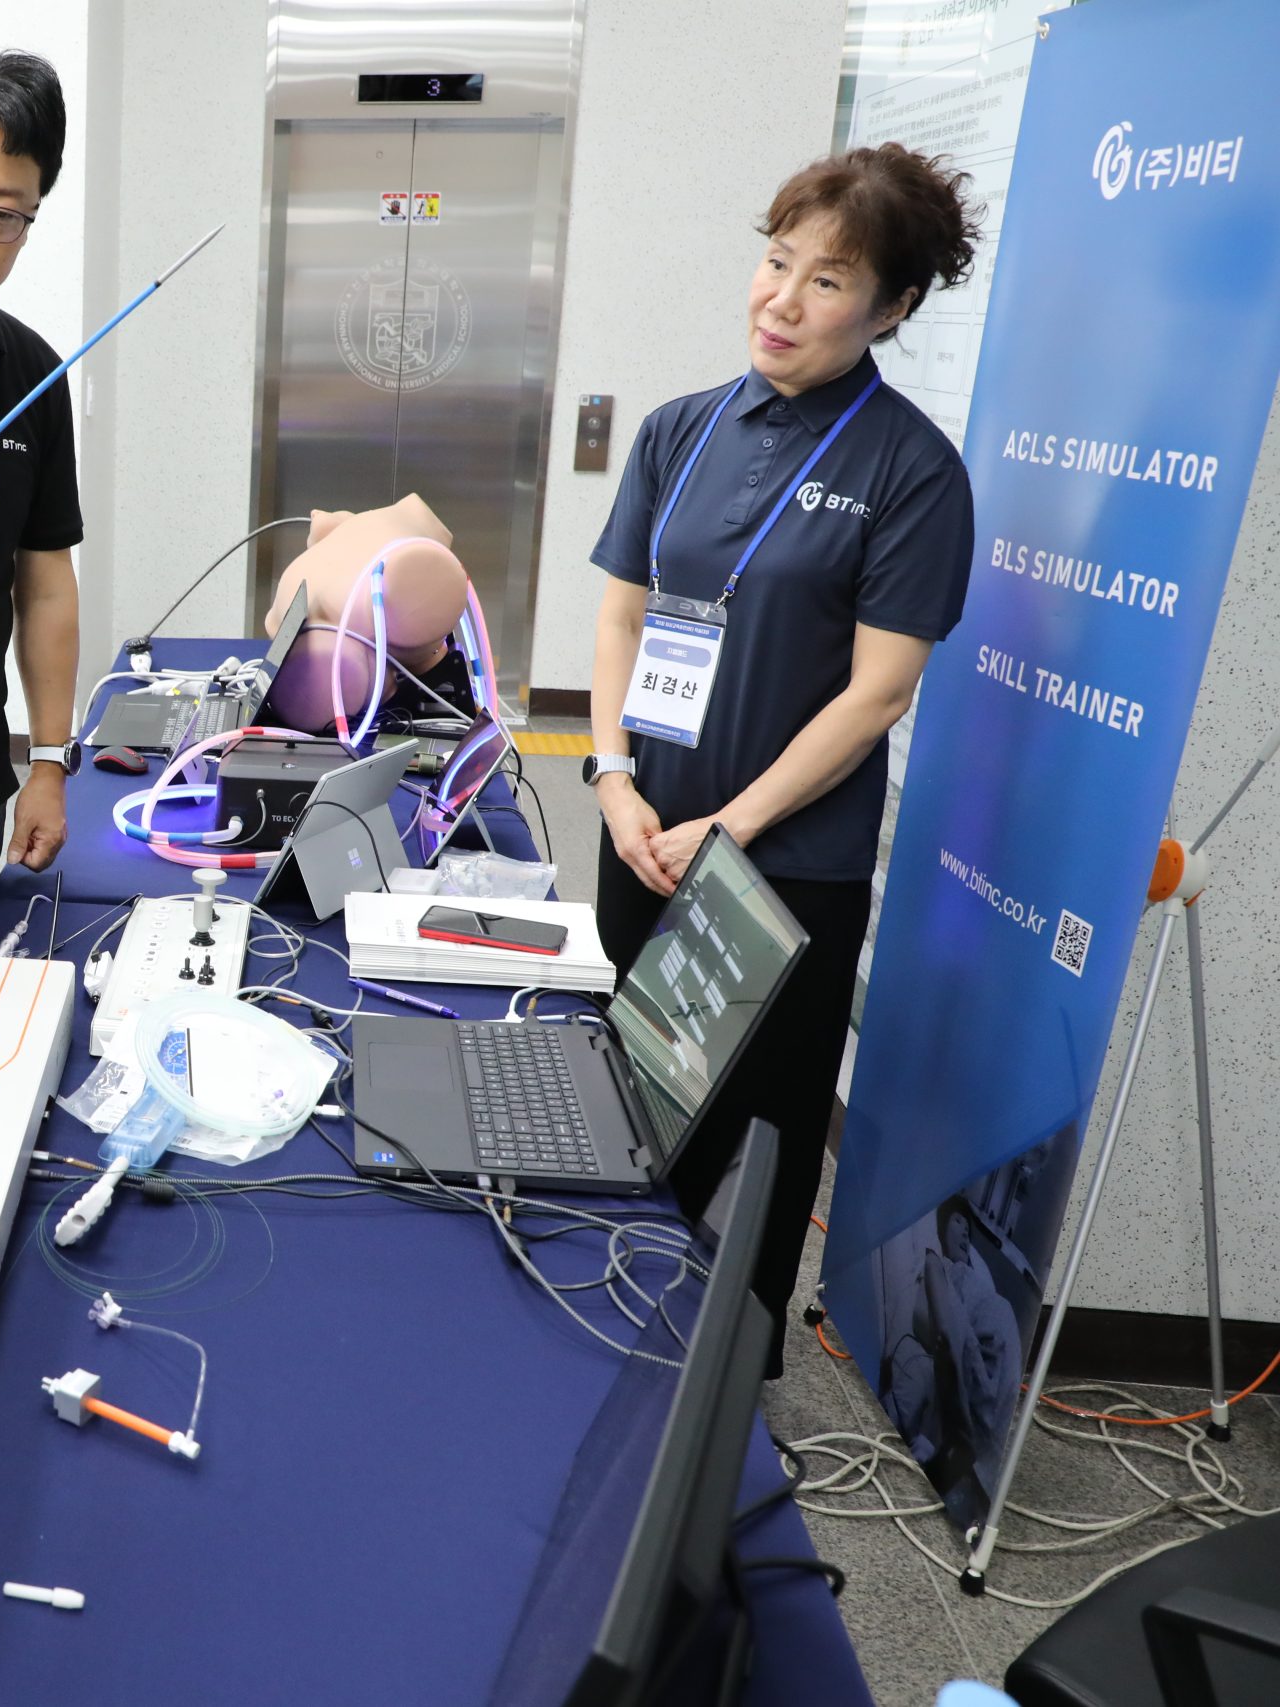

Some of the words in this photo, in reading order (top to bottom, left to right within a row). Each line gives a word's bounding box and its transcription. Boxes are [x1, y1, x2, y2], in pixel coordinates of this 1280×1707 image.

[427, 79, 441, 97] 3
[1135, 136, 1243, 191] (주)비티
[1003, 429, 1056, 466] ACLS
[1061, 438, 1219, 492] SIMULATOR
[991, 537, 1027, 576] BLS
[1031, 551, 1180, 618] SIMULATOR
[976, 643, 1028, 692] SKILL
[1035, 667, 1145, 737] TRAINER
[940, 847, 1047, 936] www.btinc.co.kr
